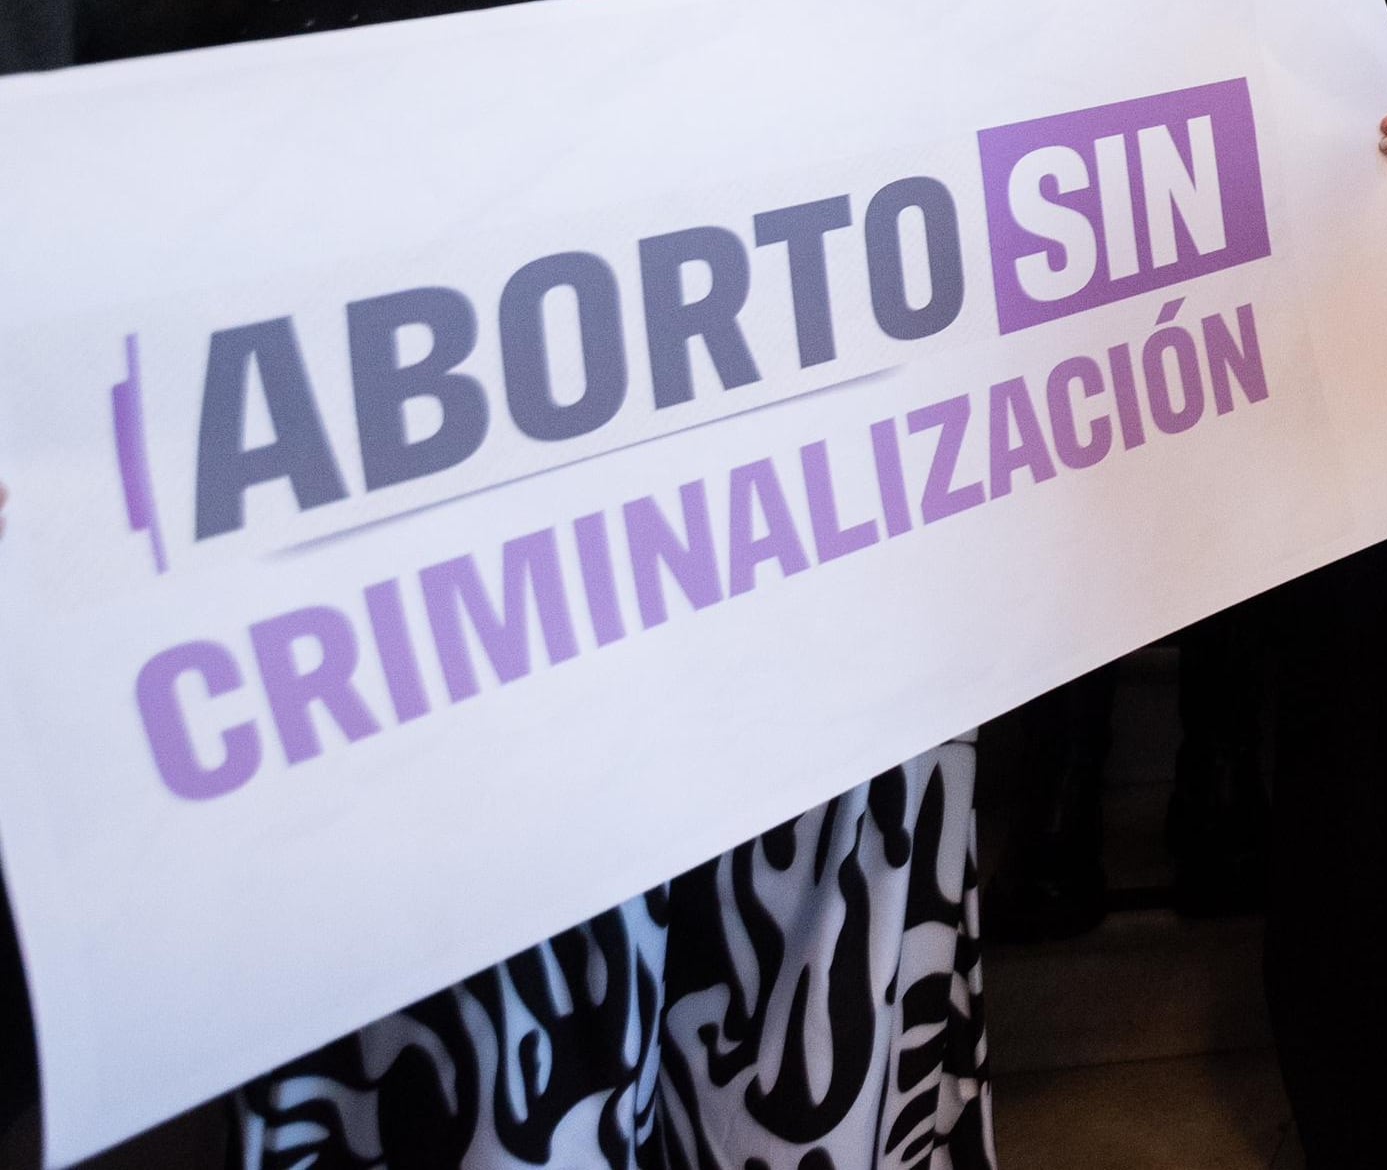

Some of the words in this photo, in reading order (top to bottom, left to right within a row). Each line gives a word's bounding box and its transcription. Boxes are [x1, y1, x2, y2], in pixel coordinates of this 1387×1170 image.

[132, 296, 1271, 803] CRIMINALIZACIÓN
[191, 174, 967, 542] ABORTO
[1006, 114, 1229, 305] SIN
